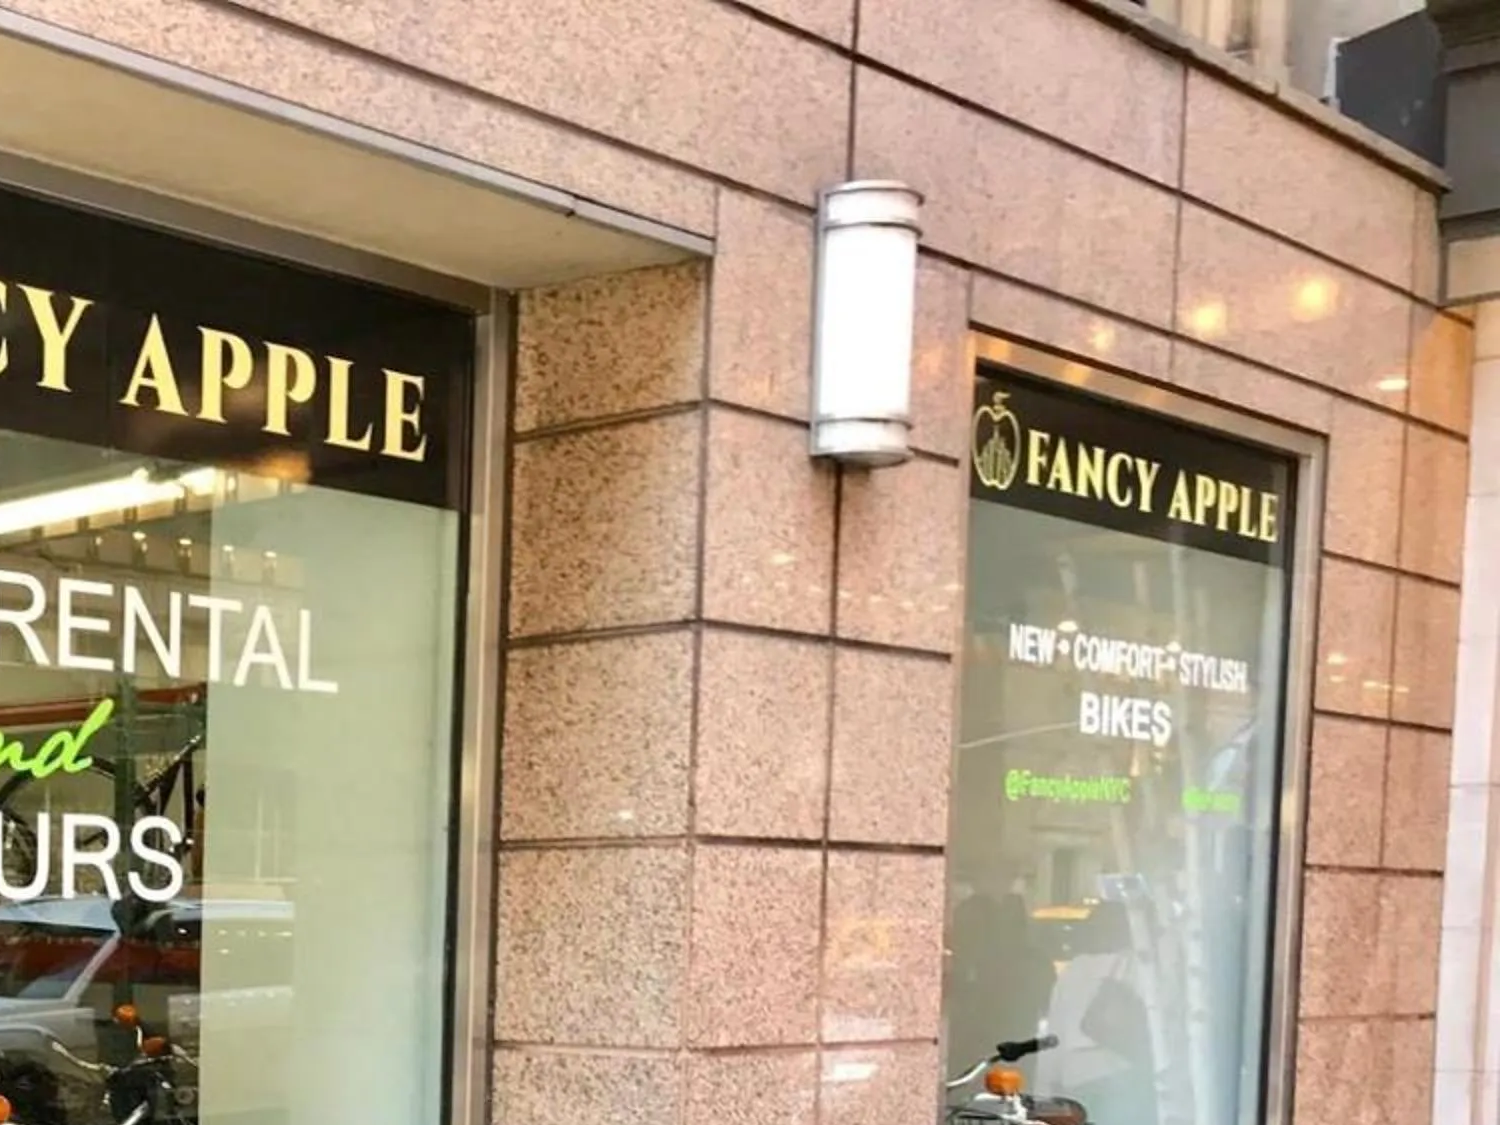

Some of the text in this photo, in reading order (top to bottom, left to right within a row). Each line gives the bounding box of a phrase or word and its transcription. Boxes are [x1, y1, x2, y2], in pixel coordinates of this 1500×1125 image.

[120, 313, 428, 463] APPLE
[1026, 429, 1278, 543] FANCY APPLE
[1009, 623, 1248, 693] NEW COMFORT STYLISH
[1080, 691, 1172, 744] BIKES
